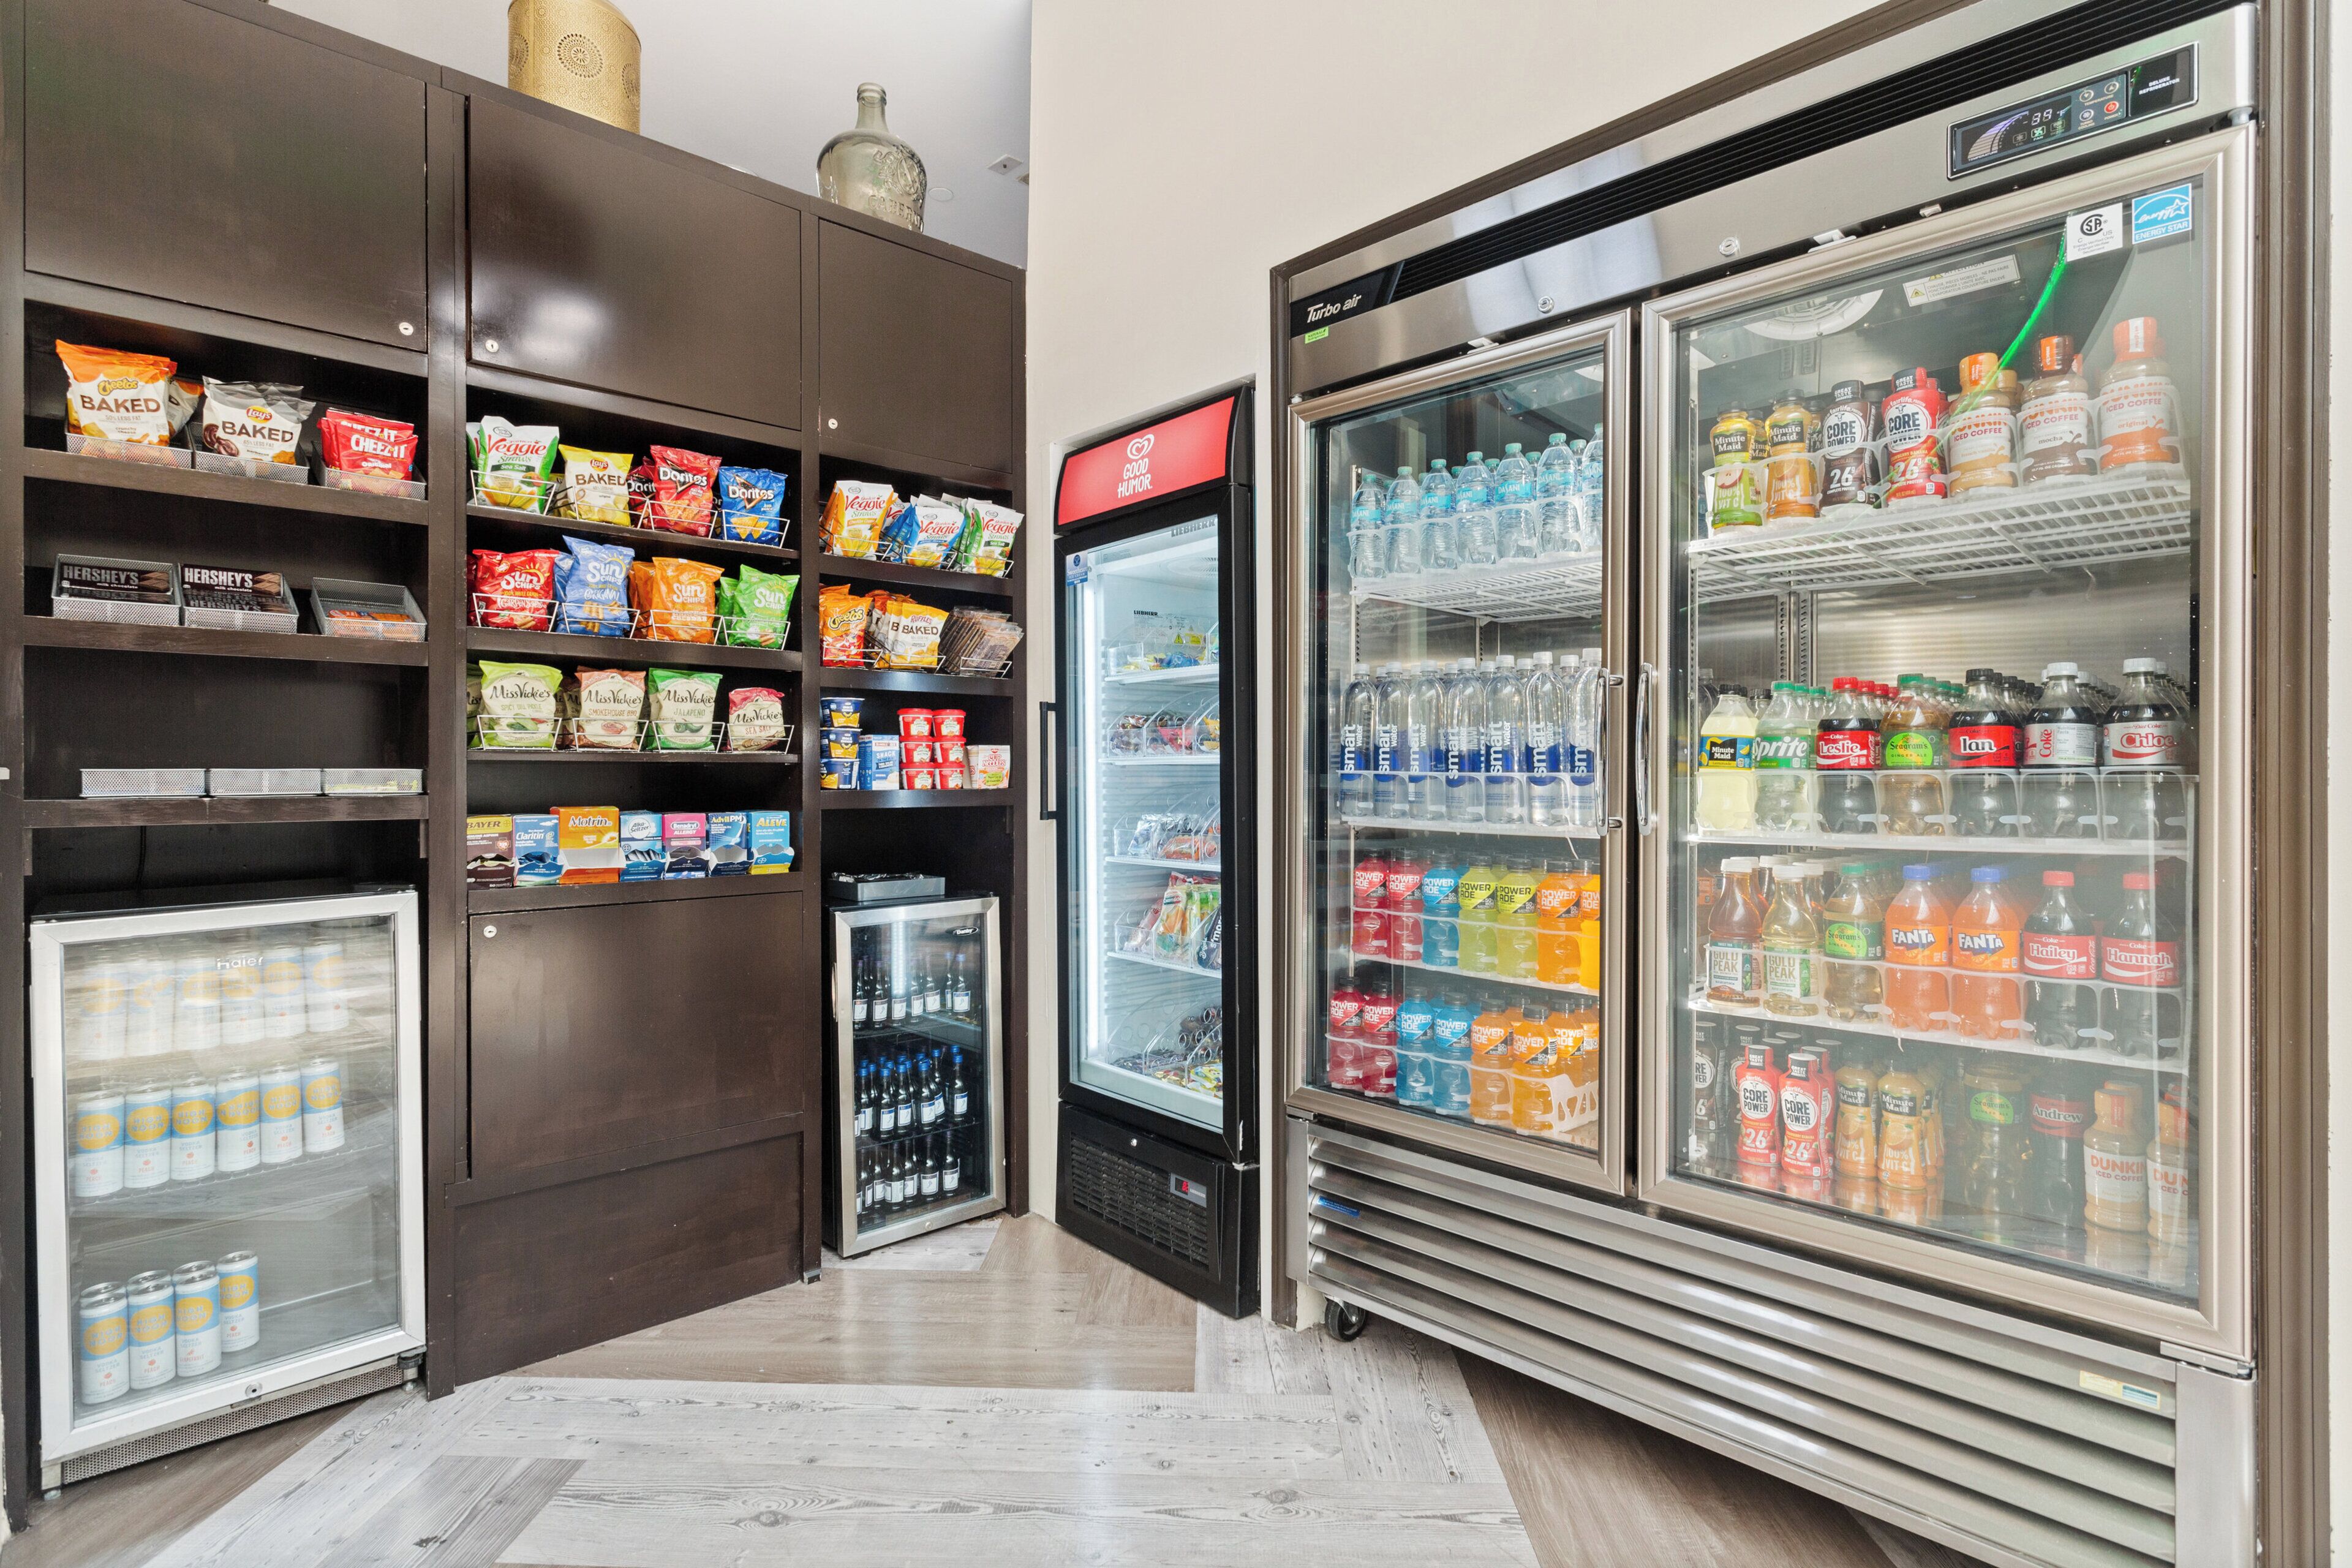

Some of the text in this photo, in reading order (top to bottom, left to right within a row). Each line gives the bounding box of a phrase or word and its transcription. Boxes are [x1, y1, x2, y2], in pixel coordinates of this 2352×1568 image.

[2139, 78, 2180, 95] REFRIGERATOR
[2149, 76, 2171, 87] DELUXE
[2084, 94, 2114, 106] TEMPERATURE
[2136, 222, 2188, 241] ENERGY STAR
[1962, 281, 1989, 290] COUVERTURE
[1307, 294, 1362, 323] Turbo air
[98, 378, 138, 396] Cheetos
[80, 394, 160, 413] BAKED
[2106, 398, 2162, 412] ICED COFFEE
[246, 407, 272, 420] Lay's
[2044, 413, 2079, 424] COFFEE
[1888, 412, 1920, 432] CORE
[2117, 420, 2149, 429] original
[222, 421, 293, 442] BAKED
[1770, 425, 1801, 437] Minute
[1826, 420, 1856, 439] CORE
[1972, 428, 2002, 439] COFFEE
[1714, 435, 1746, 446] Minute
[1773, 432, 1799, 443] Maid
[2038, 435, 2064, 445] mocha
[1718, 442, 1743, 452] Maid
[590, 459, 608, 469] Lay's
[1123, 458, 1149, 480] GOOD
[658, 466, 707, 486] Doritos
[728, 485, 774, 500] Doritos
[1498, 484, 1520, 494] DASANI
[845, 495, 886, 511] Veggie
[920, 521, 960, 535] Veggie
[64, 566, 138, 585] HERSHEY'S
[184, 567, 252, 588] HERSHEY'S
[673, 582, 706, 603] Sun
[828, 607, 865, 630] Cheetos
[911, 615, 932, 624] RUFFLES
[902, 625, 939, 635] BAKED
[490, 682, 551, 701] Miss Vickie's
[584, 690, 611, 704] Miss
[759, 725, 771, 734] SALT
[1890, 742, 1928, 750] Seagram's
[1960, 736, 1996, 753] Ian
[2120, 733, 2175, 748] Chloe
[1344, 724, 1356, 773] smart
[1410, 723, 1419, 773] smart
[1754, 736, 1807, 760] Sprite
[1820, 741, 1860, 756] Leslie
[467, 820, 500, 829] BAYER
[569, 816, 608, 827] Motrin
[756, 818, 787, 827] ALEVE
[1355, 872, 1384, 881] POWER
[1355, 878, 1370, 887] ADE
[1460, 883, 1491, 892] POWER
[1460, 890, 1475, 899] ADE
[1828, 931, 1862, 941] Seagram's
[1891, 928, 1936, 944] FANTA
[1958, 933, 2003, 950] FANTA
[1714, 951, 1739, 960] GOLD
[2030, 943, 2078, 961] Hailey
[2108, 948, 2171, 965] Hannah
[216, 956, 263, 970] Haier
[1713, 960, 1739, 972] PEAK
[1769, 967, 1795, 979] PEAK
[1743, 1088, 1768, 1102] CORE
[134, 1115, 162, 1124] HIGH
[2033, 1106, 2082, 1123] Andrew
[1746, 1129, 1766, 1148] 26
[1885, 1146, 1909, 1159] 100%
[1885, 1158, 1899, 1170] VIT
[89, 1333, 123, 1347] NOON
[97, 1359, 118, 1368] VODKA
